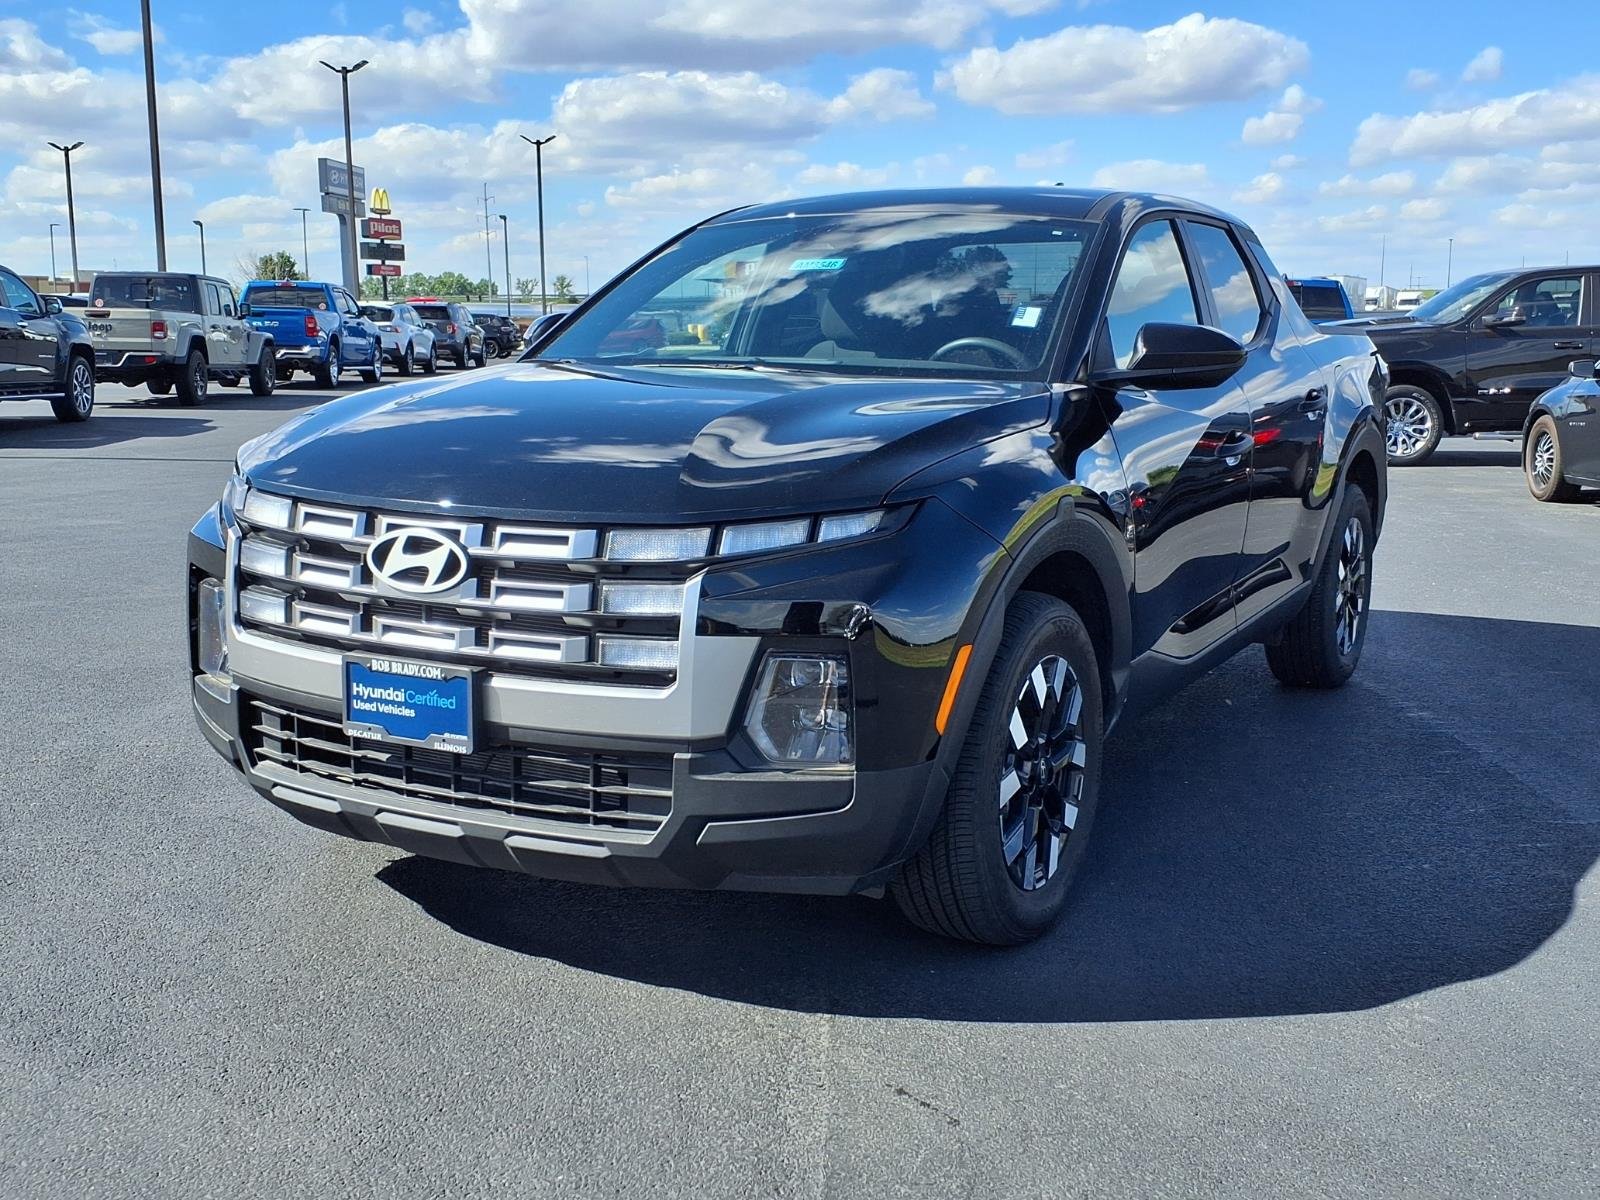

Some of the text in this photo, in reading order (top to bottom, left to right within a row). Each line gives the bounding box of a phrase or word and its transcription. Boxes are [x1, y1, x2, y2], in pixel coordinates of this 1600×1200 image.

[370, 221, 400, 234] Pilot
[371, 659, 442, 680] BOB BRADY.COM
[352, 682, 456, 709] Hyundai Certified
[353, 699, 416, 718] Used Vehicles
[348, 729, 382, 740] DECATUR
[434, 742, 467, 753] ILLINOIS
